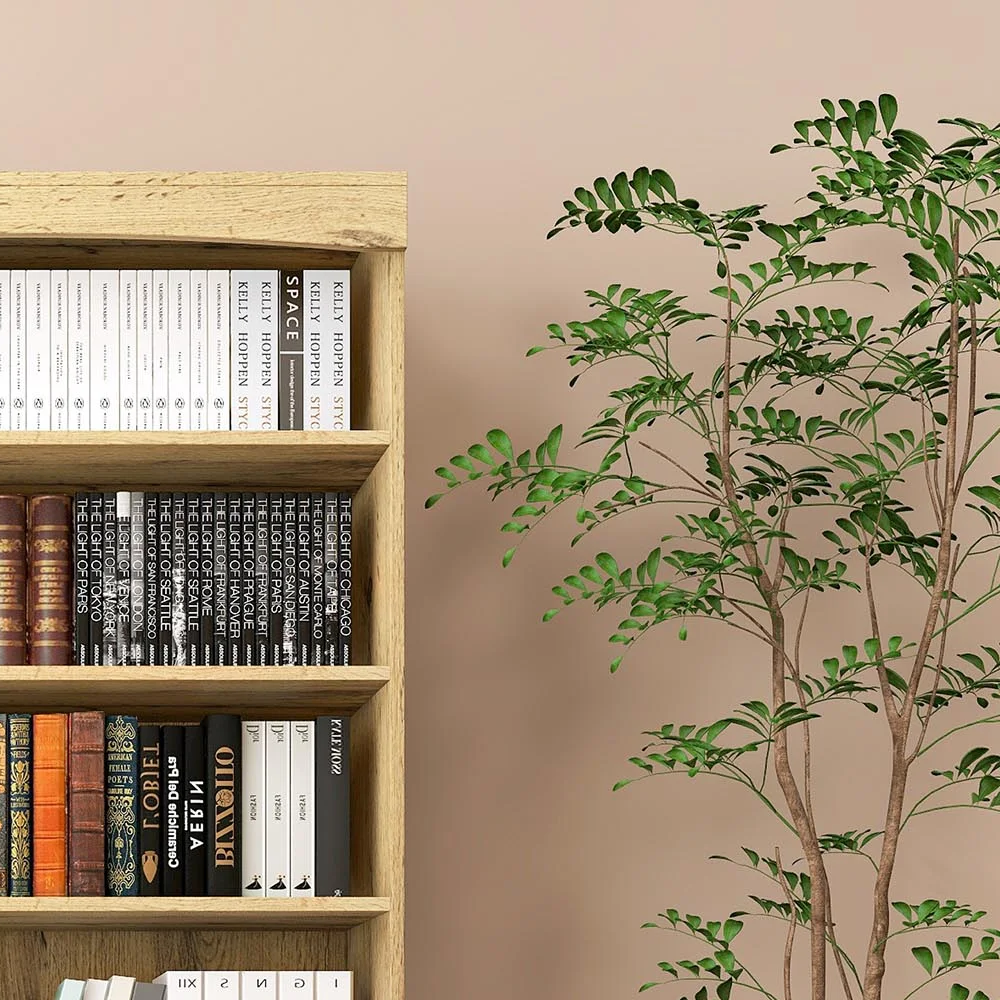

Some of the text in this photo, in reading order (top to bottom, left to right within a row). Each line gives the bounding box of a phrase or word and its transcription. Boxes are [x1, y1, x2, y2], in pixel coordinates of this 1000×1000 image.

[238, 281, 249, 323] KELLY
[261, 281, 272, 323] KELLY
[286, 276, 299, 341] SPACE
[310, 281, 321, 323] KELLY
[333, 281, 344, 323] KELLY
[238, 332, 249, 387] HOPPEN
[261, 332, 272, 387] HOPPEN
[310, 332, 321, 387] HOPPEN
[333, 332, 344, 387] HOPPEN
[77, 498, 88, 614] THE LIGHT OF PARIS
[91, 498, 102, 622] THE LIGHT OF TOKYO
[133, 498, 143, 632] THE LIGHT OF LONDON
[147, 498, 156, 639] THE LIGHT OF SAN FRANCISCO
[230, 498, 240, 638] THE LIGHT OF HANOVER
[340, 498, 351, 636] THE LIGHT OF CHICAGO
[107, 776, 134, 784] POETS
